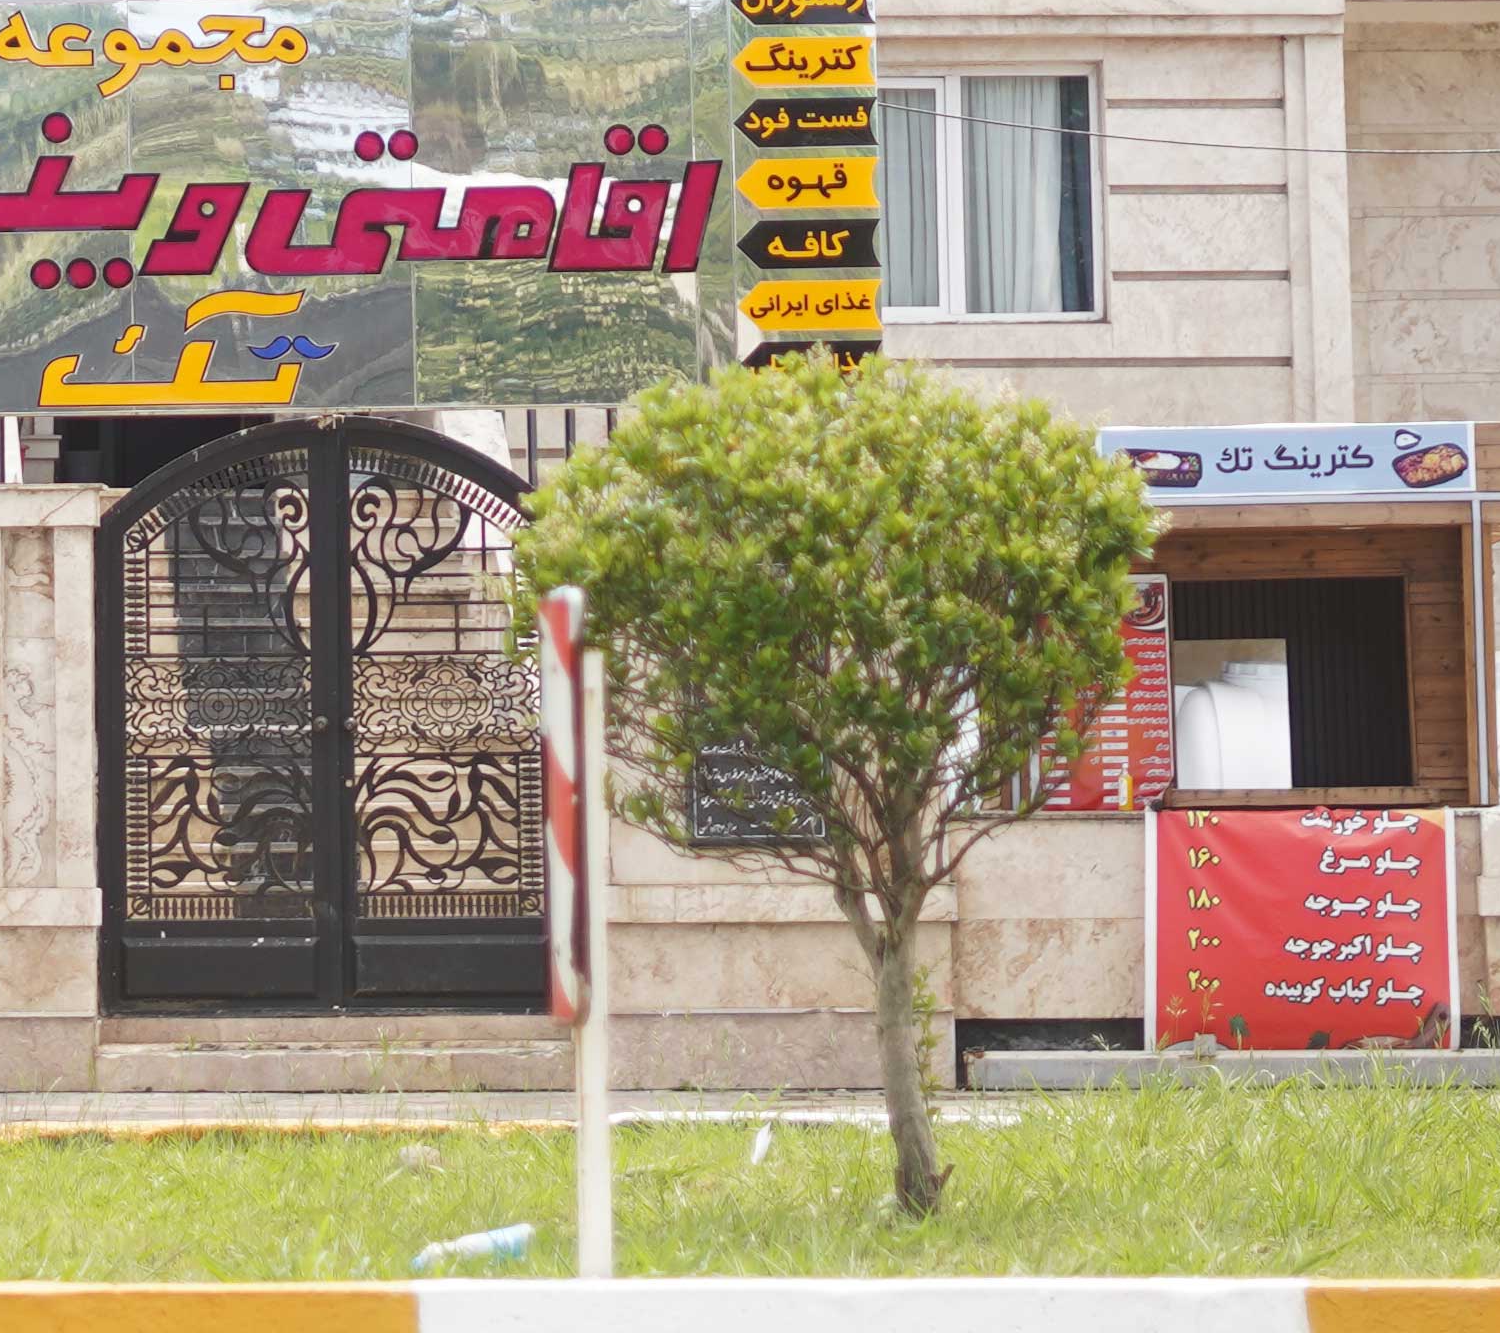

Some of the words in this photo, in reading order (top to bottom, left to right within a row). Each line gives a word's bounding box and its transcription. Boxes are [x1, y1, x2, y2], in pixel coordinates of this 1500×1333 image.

[745, 43, 863, 80] کترینگ
[744, 106, 791, 139] فود
[797, 104, 869, 129] فست
[767, 162, 848, 202] قهوه
[767, 229, 850, 259] کافه
[750, 293, 809, 319] ایرانی
[815, 291, 871, 317] غذای
[1264, 443, 1374, 478] کترینگ
[1300, 810, 1368, 835] خورشت
[1373, 810, 1420, 833] چلو
[1186, 846, 1221, 869] ۱۶۰
[1319, 845, 1372, 875] مرغ
[1374, 848, 1421, 877] چلو
[1187, 886, 1221, 910] ۱۸۰
[1303, 893, 1371, 918] جوجه
[1374, 891, 1422, 920] چلو
[1186, 928, 1221, 951] ۲۰۰
[1375, 933, 1424, 964] چلو
[1186, 969, 1221, 992] ۲۰۰
[1263, 977, 1326, 1004] کوبیده
[1327, 976, 1373, 1005] کباب
[1375, 978, 1425, 1008] چلو
